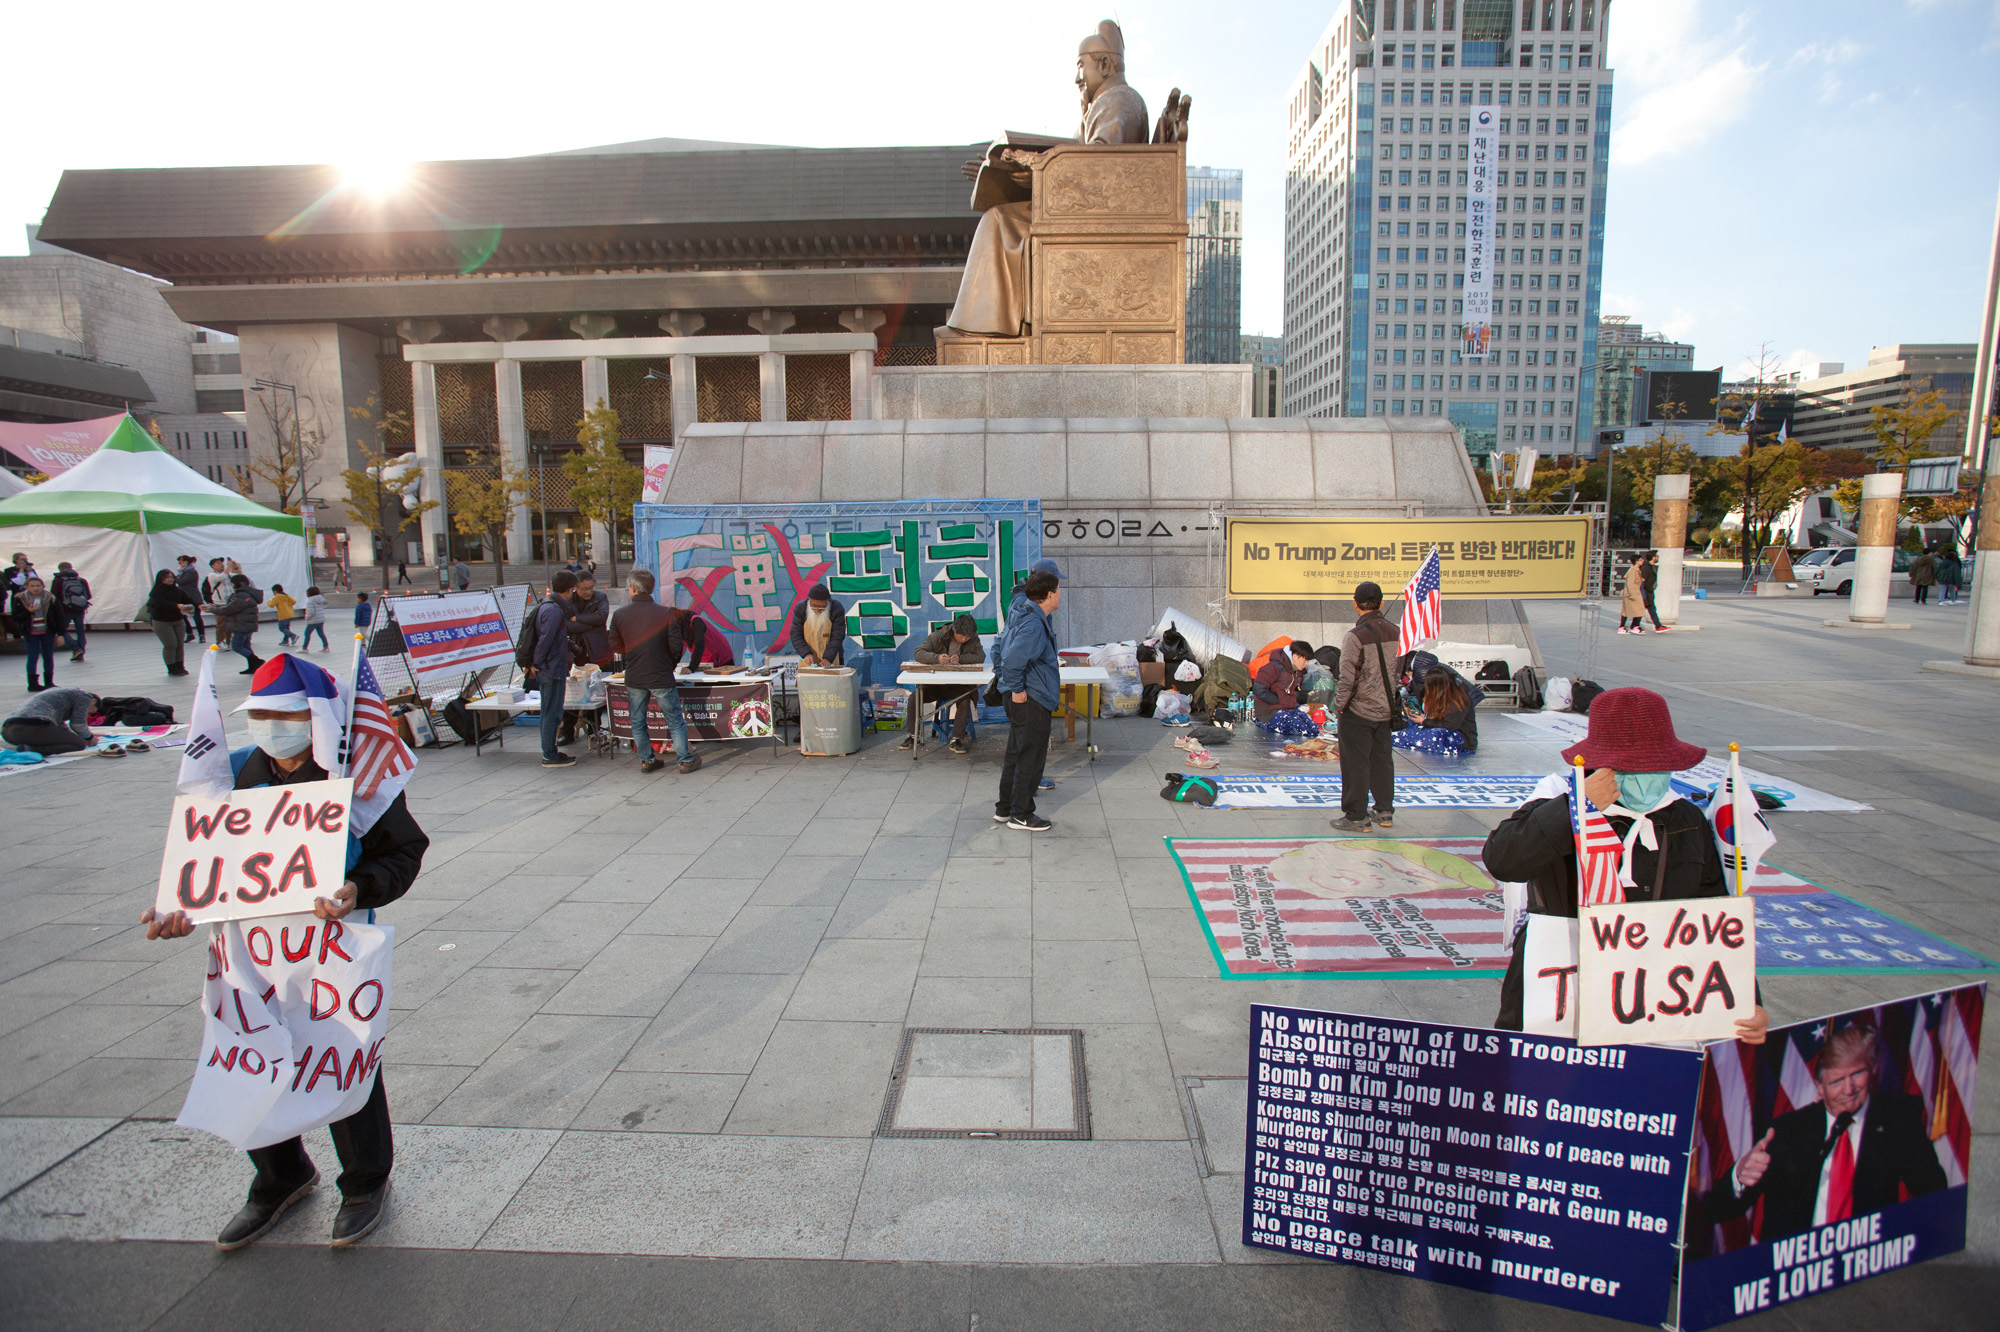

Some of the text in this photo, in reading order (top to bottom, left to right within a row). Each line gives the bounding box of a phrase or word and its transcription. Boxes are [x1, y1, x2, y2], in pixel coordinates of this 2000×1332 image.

[1474, 138, 1487, 193] 재난대응
[1470, 200, 1485, 283] 안전한국훈련
[1244, 540, 1576, 565] No Trump Zone! 트럼프 방한 반대한다!
[410, 632, 432, 645] 미국은
[184, 790, 345, 842] We love
[178, 844, 318, 910] U.S.A
[1239, 909, 1261, 930] North
[1346, 899, 1406, 959] on North Korea
[1380, 914, 1404, 929] and
[1395, 898, 1425, 921] willing
[1416, 922, 1433, 932] to
[1590, 908, 1745, 951] We love
[247, 920, 354, 966] OUR
[1271, 942, 1292, 958] but
[311, 979, 383, 1022] DO
[1612, 960, 1736, 1025] U.S.A
[1259, 1047, 1420, 1079] 미군철수 반대!!! 절대 반대!!
[1260, 1029, 1457, 1068] Absolutely Not!!
[1261, 1011, 1627, 1069] No withdrawl of U.S Troops!!!
[1258, 1062, 1677, 1137] Bomb on Kim Jong Un & His Gangsters!!
[1258, 1084, 1412, 1117] 김정은과 깡패집단을 폭격!!
[1256, 1116, 1431, 1158] Murderer Kim Jong Un
[1257, 1100, 1671, 1175] Koreans shudder when Moon talks of peace with
[1255, 1150, 1668, 1234] Plz save our true President Park Geun Hae
[1256, 1134, 1603, 1200] 문이 살인마 김정은과 평화 논할 때 한국인들은 몸서리 친다.
[1252, 1198, 1331, 1224] 죄가 없습니다.
[1254, 1168, 1477, 1220] from jail she's innocent
[1254, 1186, 1554, 1249] 우리의 진정한 대통령 박근혜를 감옥에서 구해주세요.
[1252, 1230, 1416, 1273] 살인마 김정은과 평화협정반대
[1253, 1212, 1621, 1297] No peace talk with murderer
[1773, 1212, 1882, 1271] WELCOME
[1734, 1234, 1917, 1315] WE LOVE TRUMP
